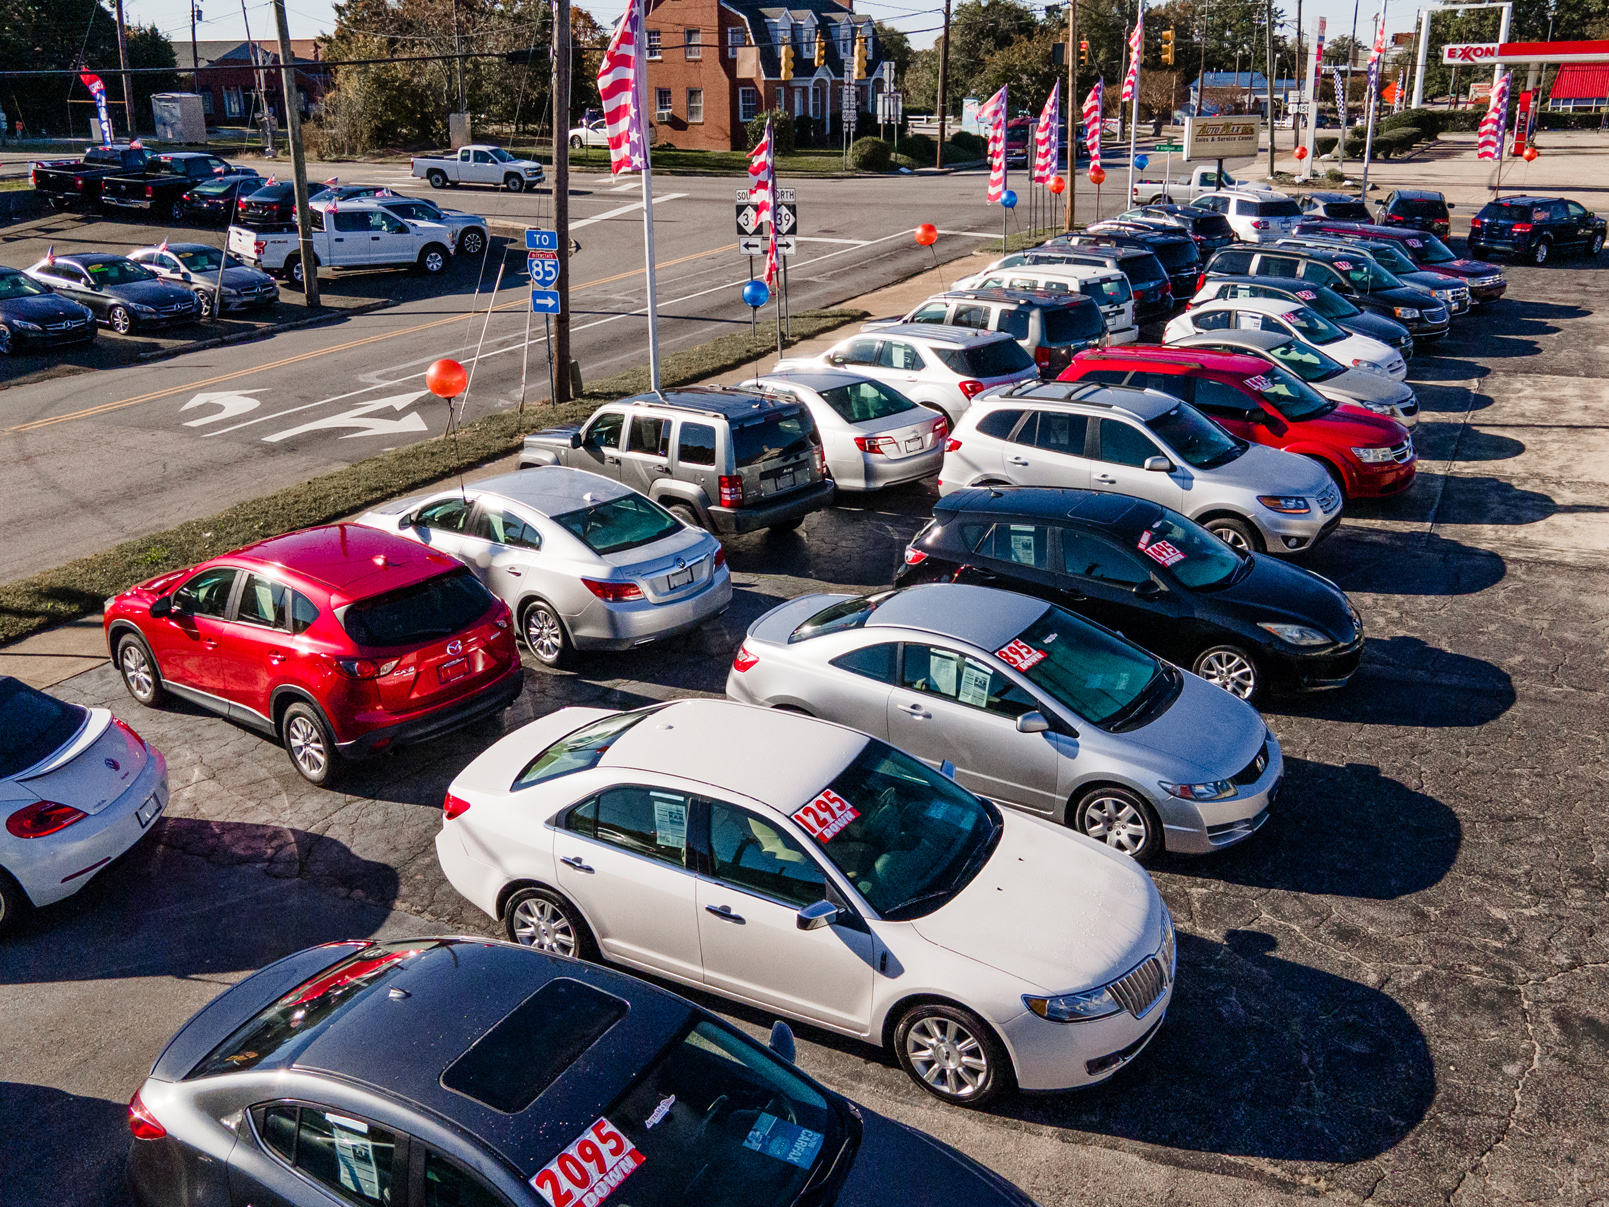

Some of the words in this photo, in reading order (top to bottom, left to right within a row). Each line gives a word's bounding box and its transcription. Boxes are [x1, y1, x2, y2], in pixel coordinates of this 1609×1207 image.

[1447, 46, 1496, 62] EXXON
[1198, 122, 1220, 135] AUTO
[1220, 121, 1241, 134] MAX
[737, 191, 751, 201] SOU
[776, 190, 795, 200] ORTH
[776, 212, 791, 226] 39
[533, 234, 550, 246] TO
[531, 260, 556, 281] 85
[1145, 540, 1177, 563] 1495
[997, 639, 1033, 666] 895
[1018, 651, 1045, 671] DOWN
[793, 789, 847, 835] 1295
[821, 809, 856, 839] DOWN
[786, 1128, 813, 1163] CARFAX
[535, 1118, 626, 1207] 2095
[580, 1154, 639, 1207] DOWN
